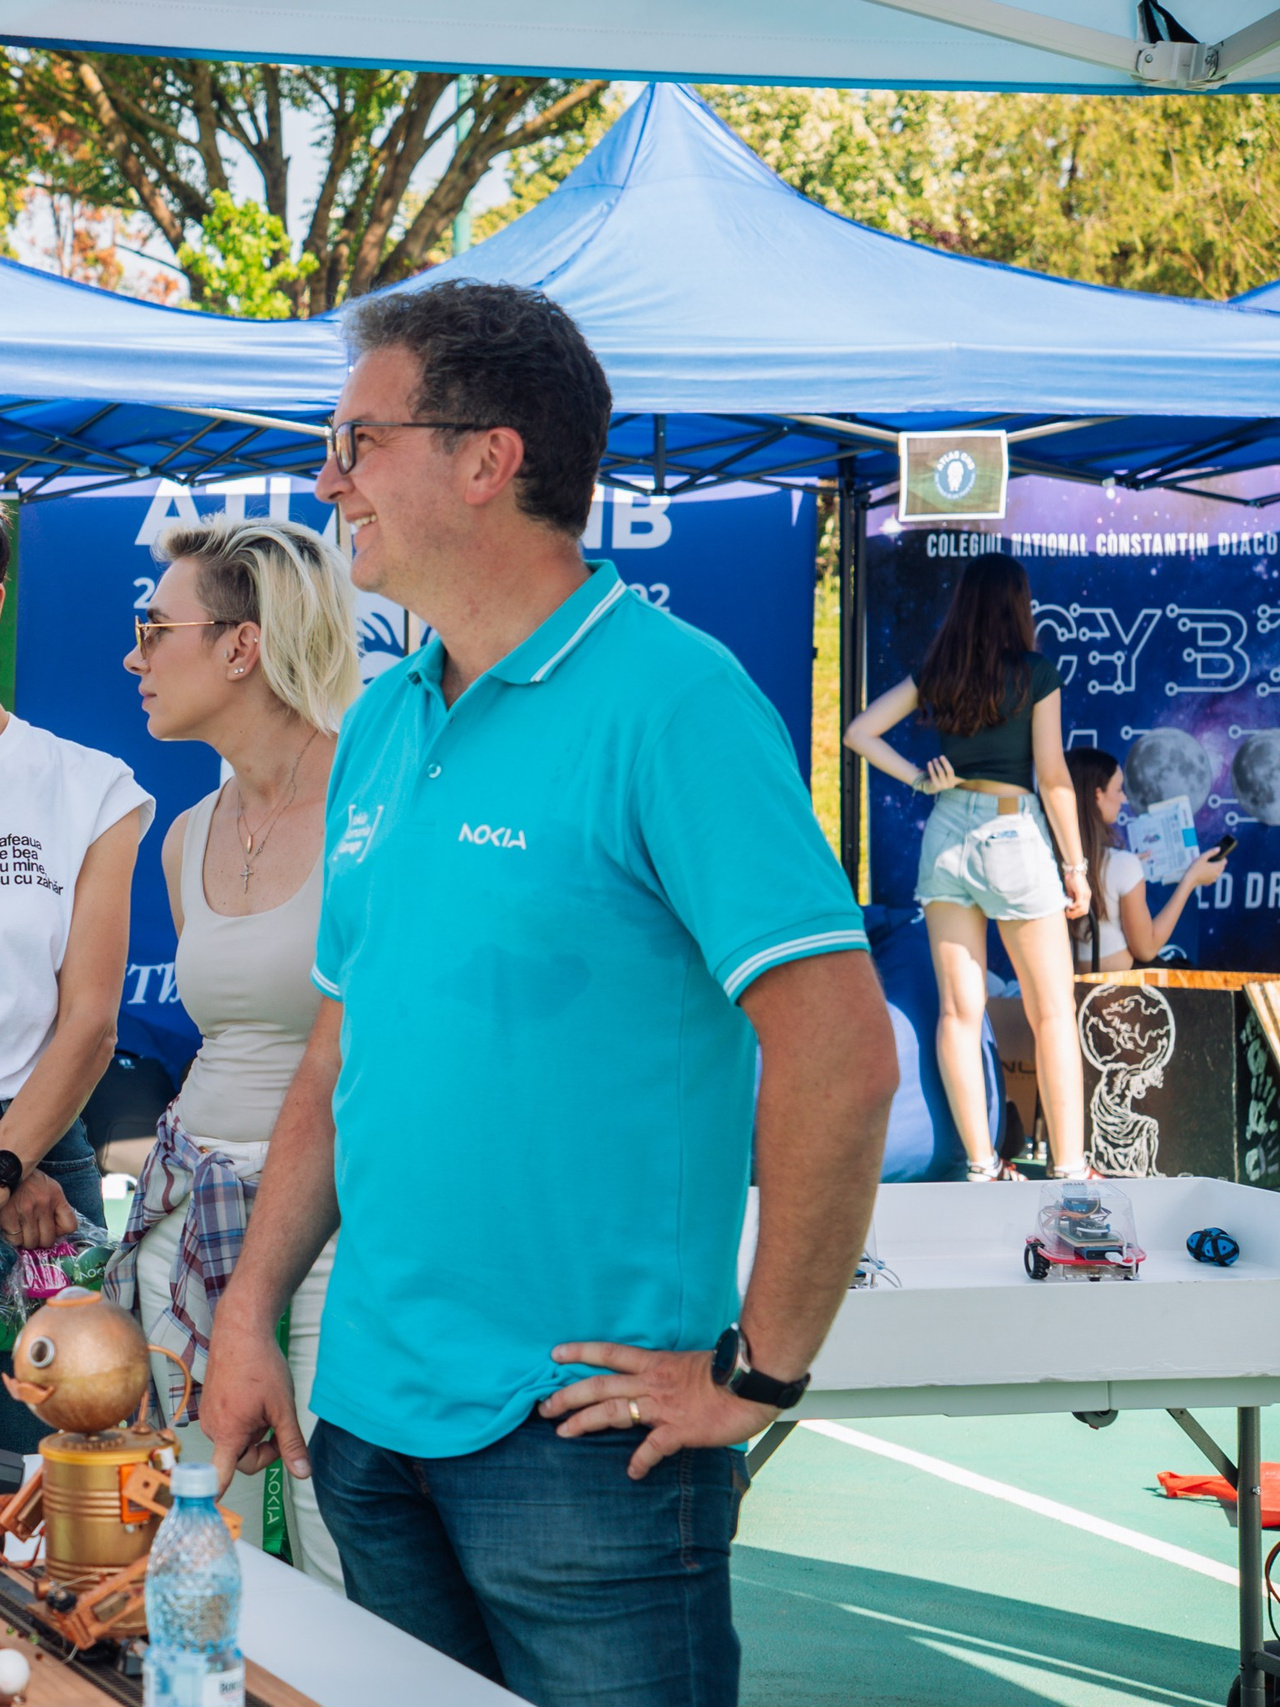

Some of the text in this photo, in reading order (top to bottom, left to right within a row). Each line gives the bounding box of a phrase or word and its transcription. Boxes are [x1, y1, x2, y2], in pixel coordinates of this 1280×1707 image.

[1011, 533, 1089, 557] NATIONAL
[1095, 533, 1209, 557] CONSTANTIN
[458, 822, 527, 850] NOKIA
[12, 846, 39, 860] bea
[14, 874, 33, 885] cu
[267, 1468, 281, 1525] NOKIA
